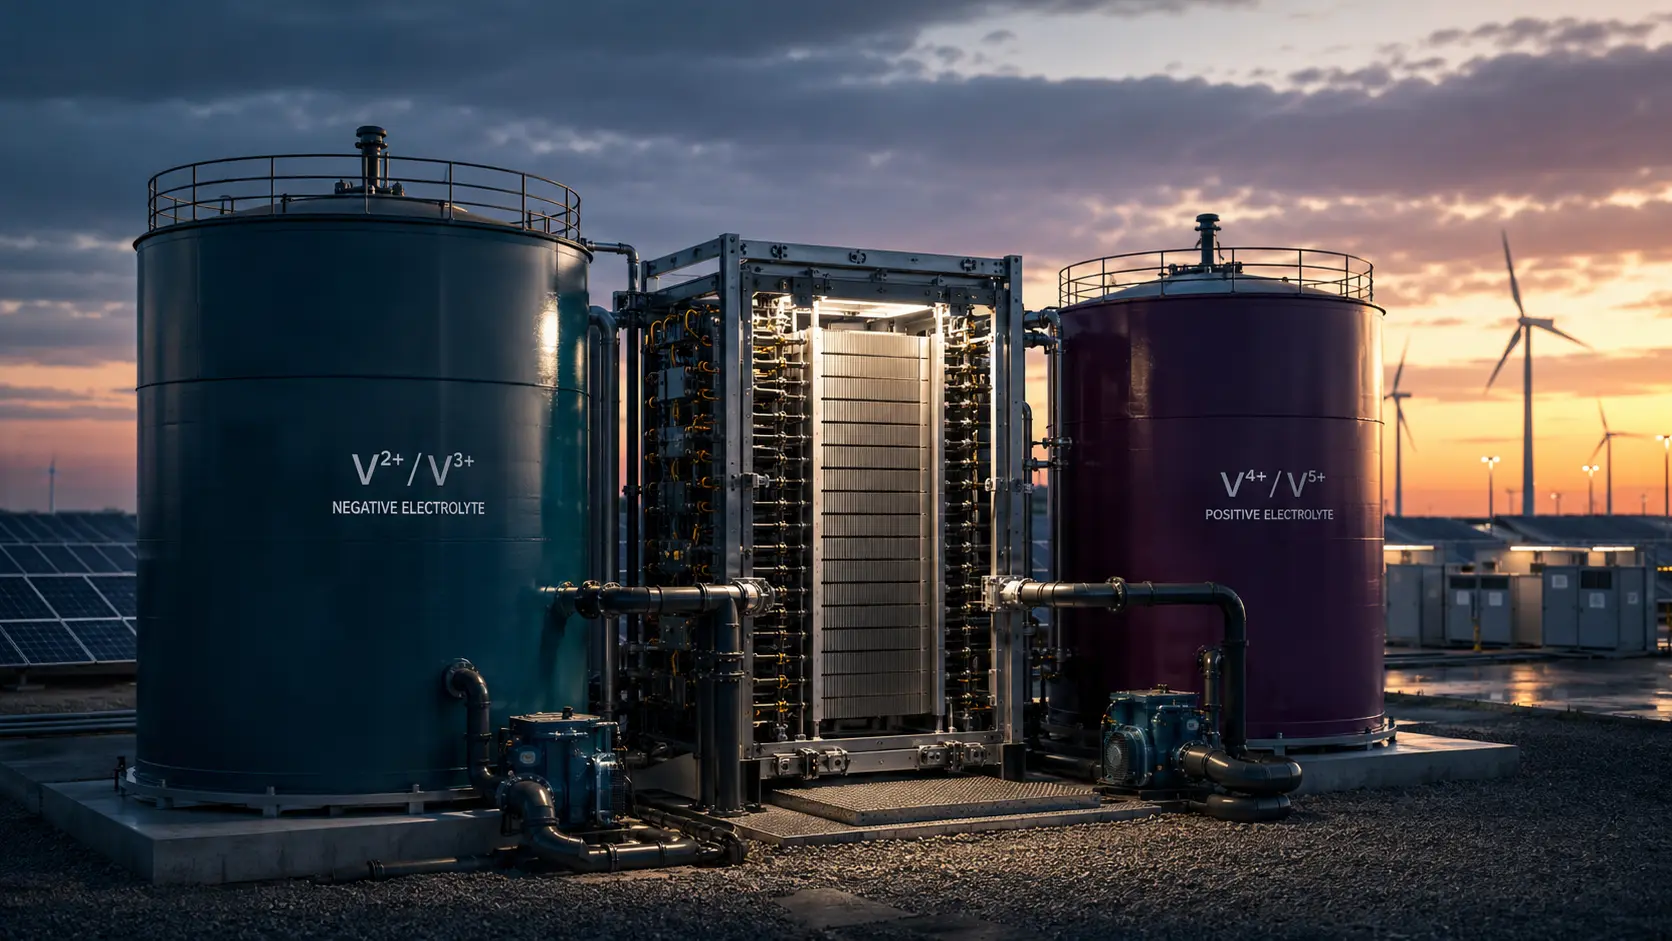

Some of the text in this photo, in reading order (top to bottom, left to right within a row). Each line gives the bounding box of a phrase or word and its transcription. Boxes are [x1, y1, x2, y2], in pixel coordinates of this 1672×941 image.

[332, 500, 485, 515] NEGATIVE ELECTROLYTE
[1205, 508, 1334, 520] POSITIVE ELECTROLYTE
